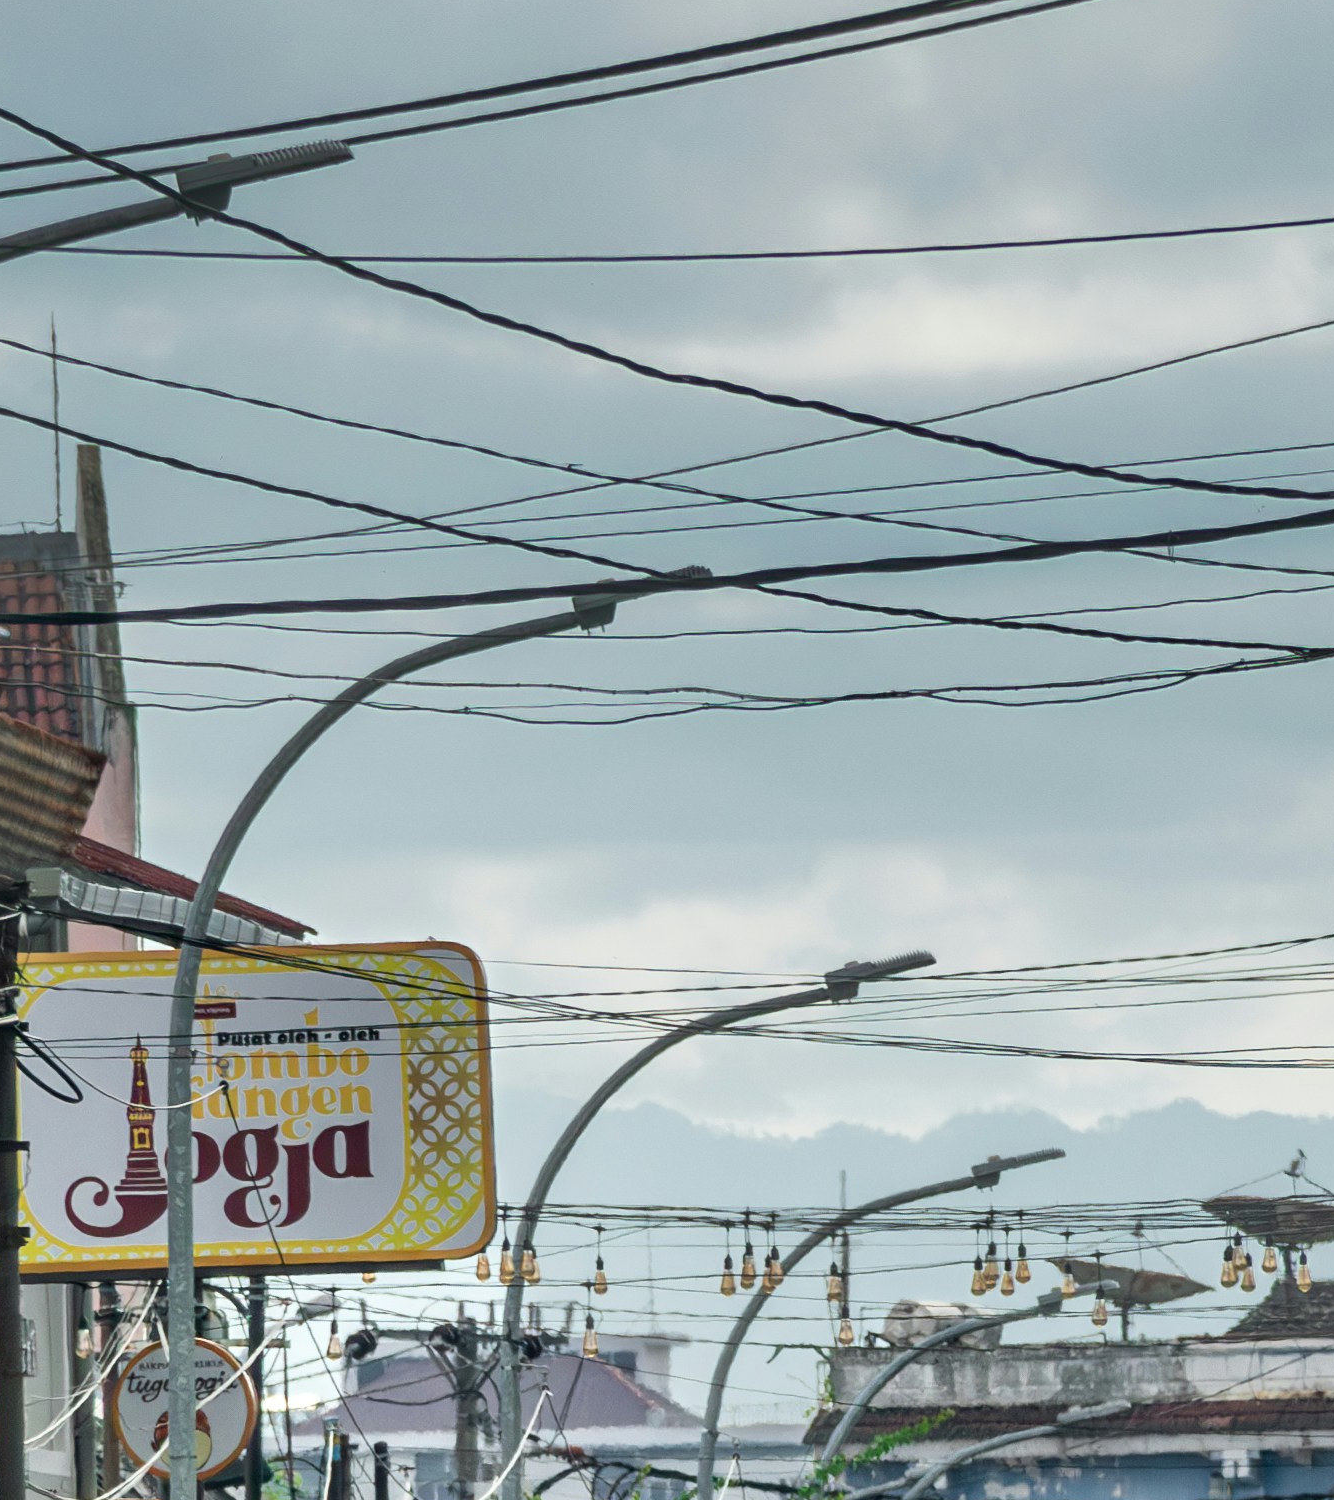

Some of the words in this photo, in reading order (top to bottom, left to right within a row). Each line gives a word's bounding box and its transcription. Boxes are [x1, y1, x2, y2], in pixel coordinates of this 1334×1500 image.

[218, 1031, 273, 1047] Pusat
[277, 1028, 318, 1044] oleh
[338, 1028, 380, 1043] oleh
